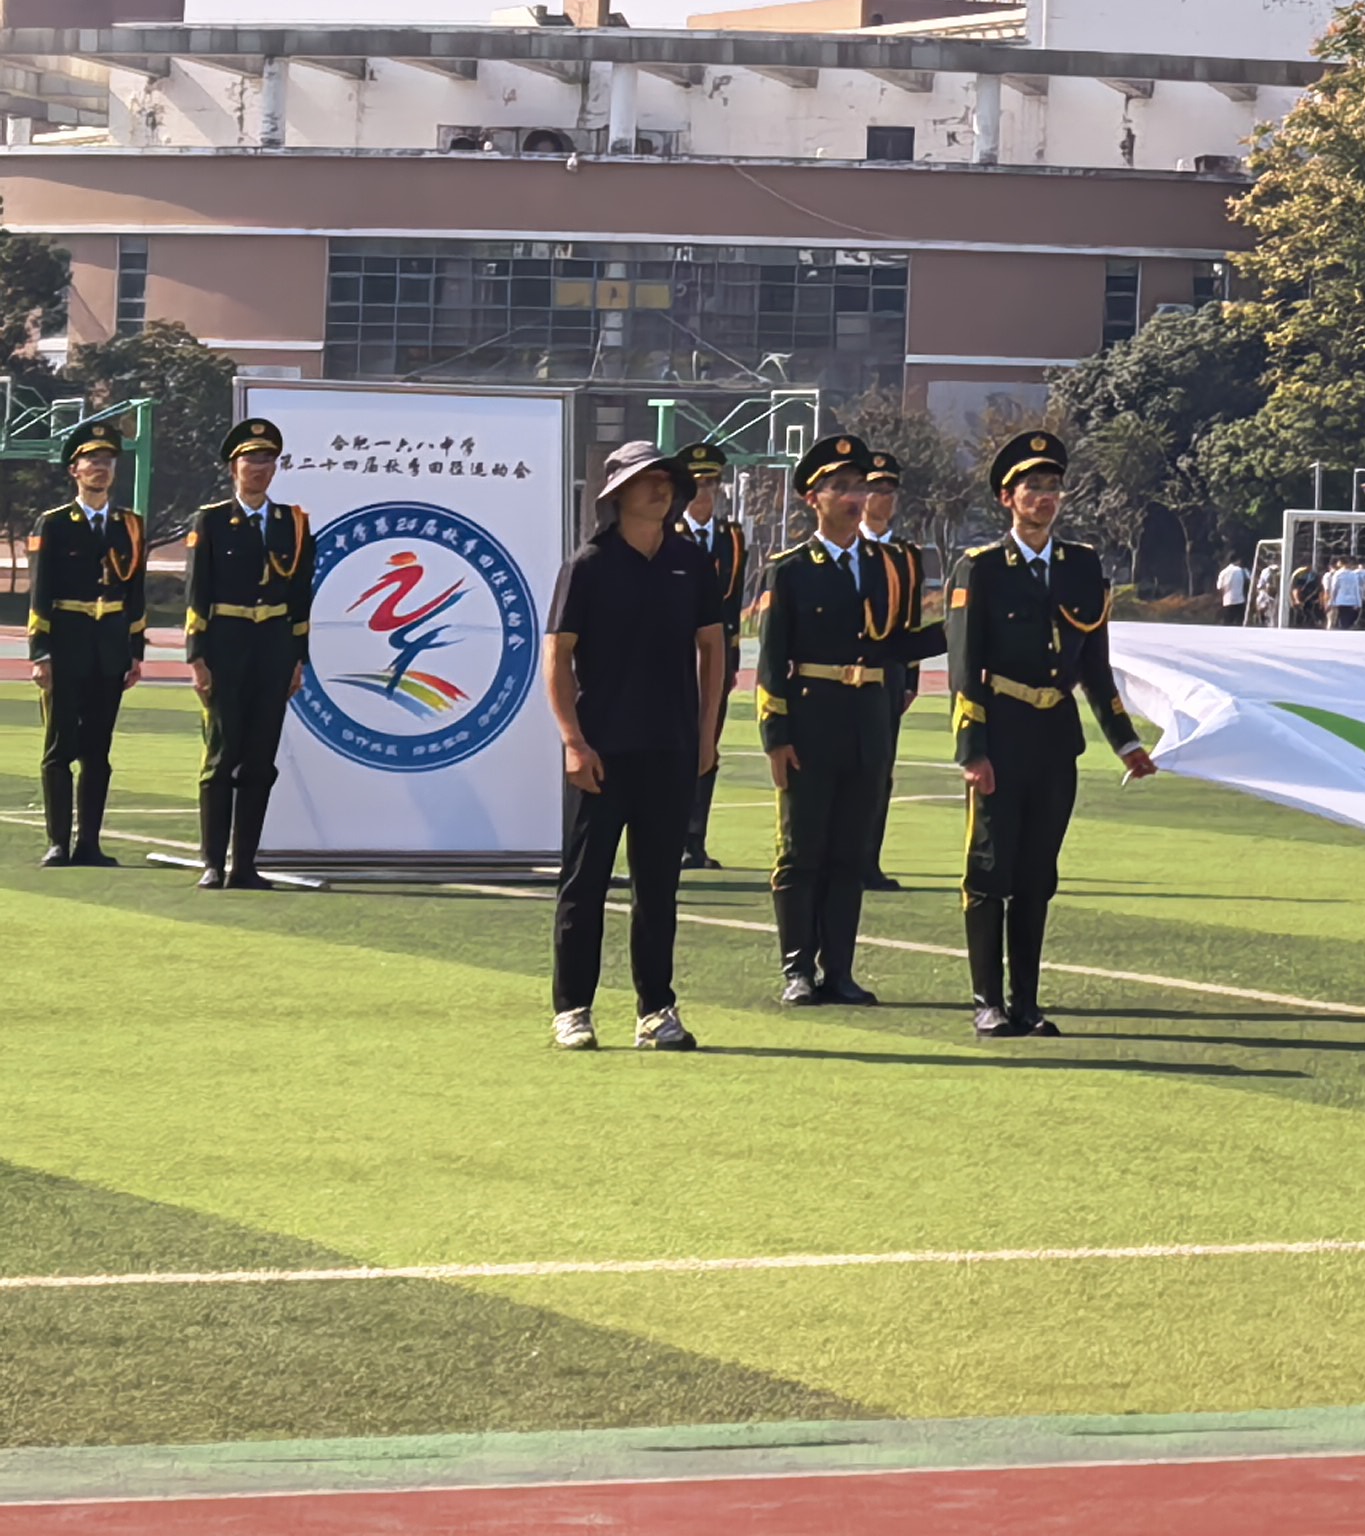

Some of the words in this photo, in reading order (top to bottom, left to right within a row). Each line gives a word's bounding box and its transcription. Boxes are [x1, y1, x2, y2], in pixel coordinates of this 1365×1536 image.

[330, 434, 476, 457] 合肥一六八中学
